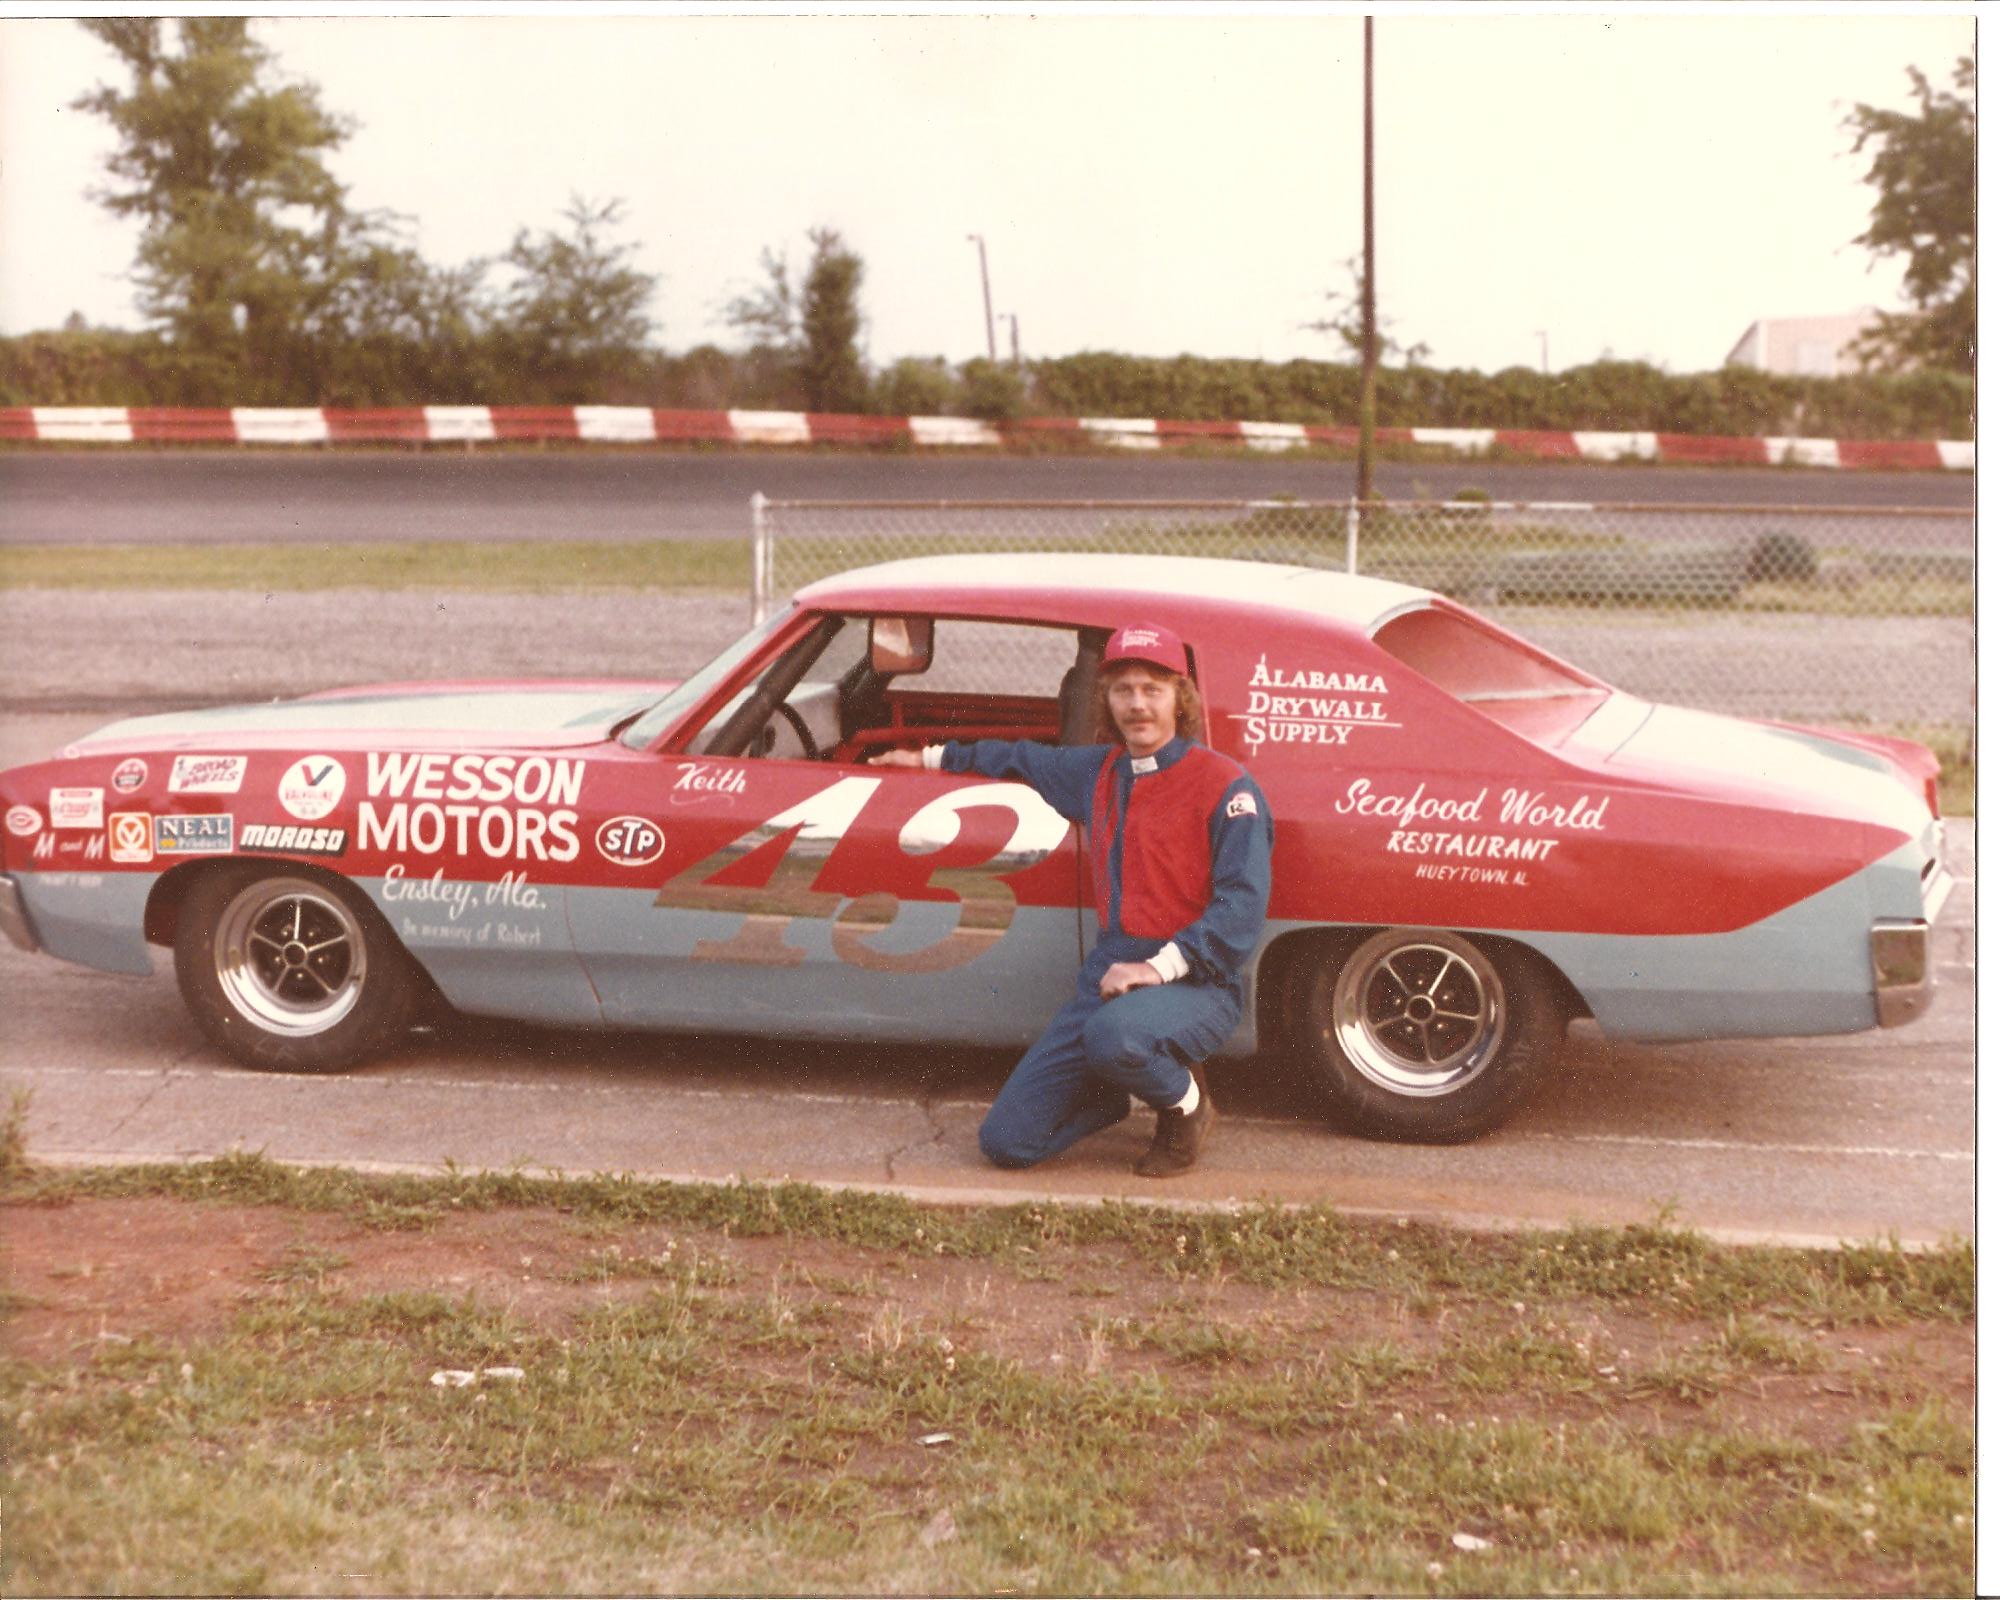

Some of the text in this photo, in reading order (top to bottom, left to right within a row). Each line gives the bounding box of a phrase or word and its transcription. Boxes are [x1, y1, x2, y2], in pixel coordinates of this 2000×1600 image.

[1248, 662, 1389, 694] ALABAMA
[1247, 691, 1388, 720] DRYWALL
[1243, 716, 1353, 745] SUPPLY
[366, 751, 586, 806] WESSON
[673, 762, 747, 794] Keith
[1335, 778, 1611, 831] Seafood World
[161, 818, 229, 837] NEAL
[240, 824, 346, 853] MOROSO
[357, 801, 581, 862] MOTORS
[605, 821, 656, 855] STP
[1386, 830, 1560, 861] RESTAURANT
[651, 776, 1070, 974] 43
[381, 863, 547, 920] Ensley, Ala.
[477, 921, 492, 942] of
[498, 921, 542, 945] Robert
